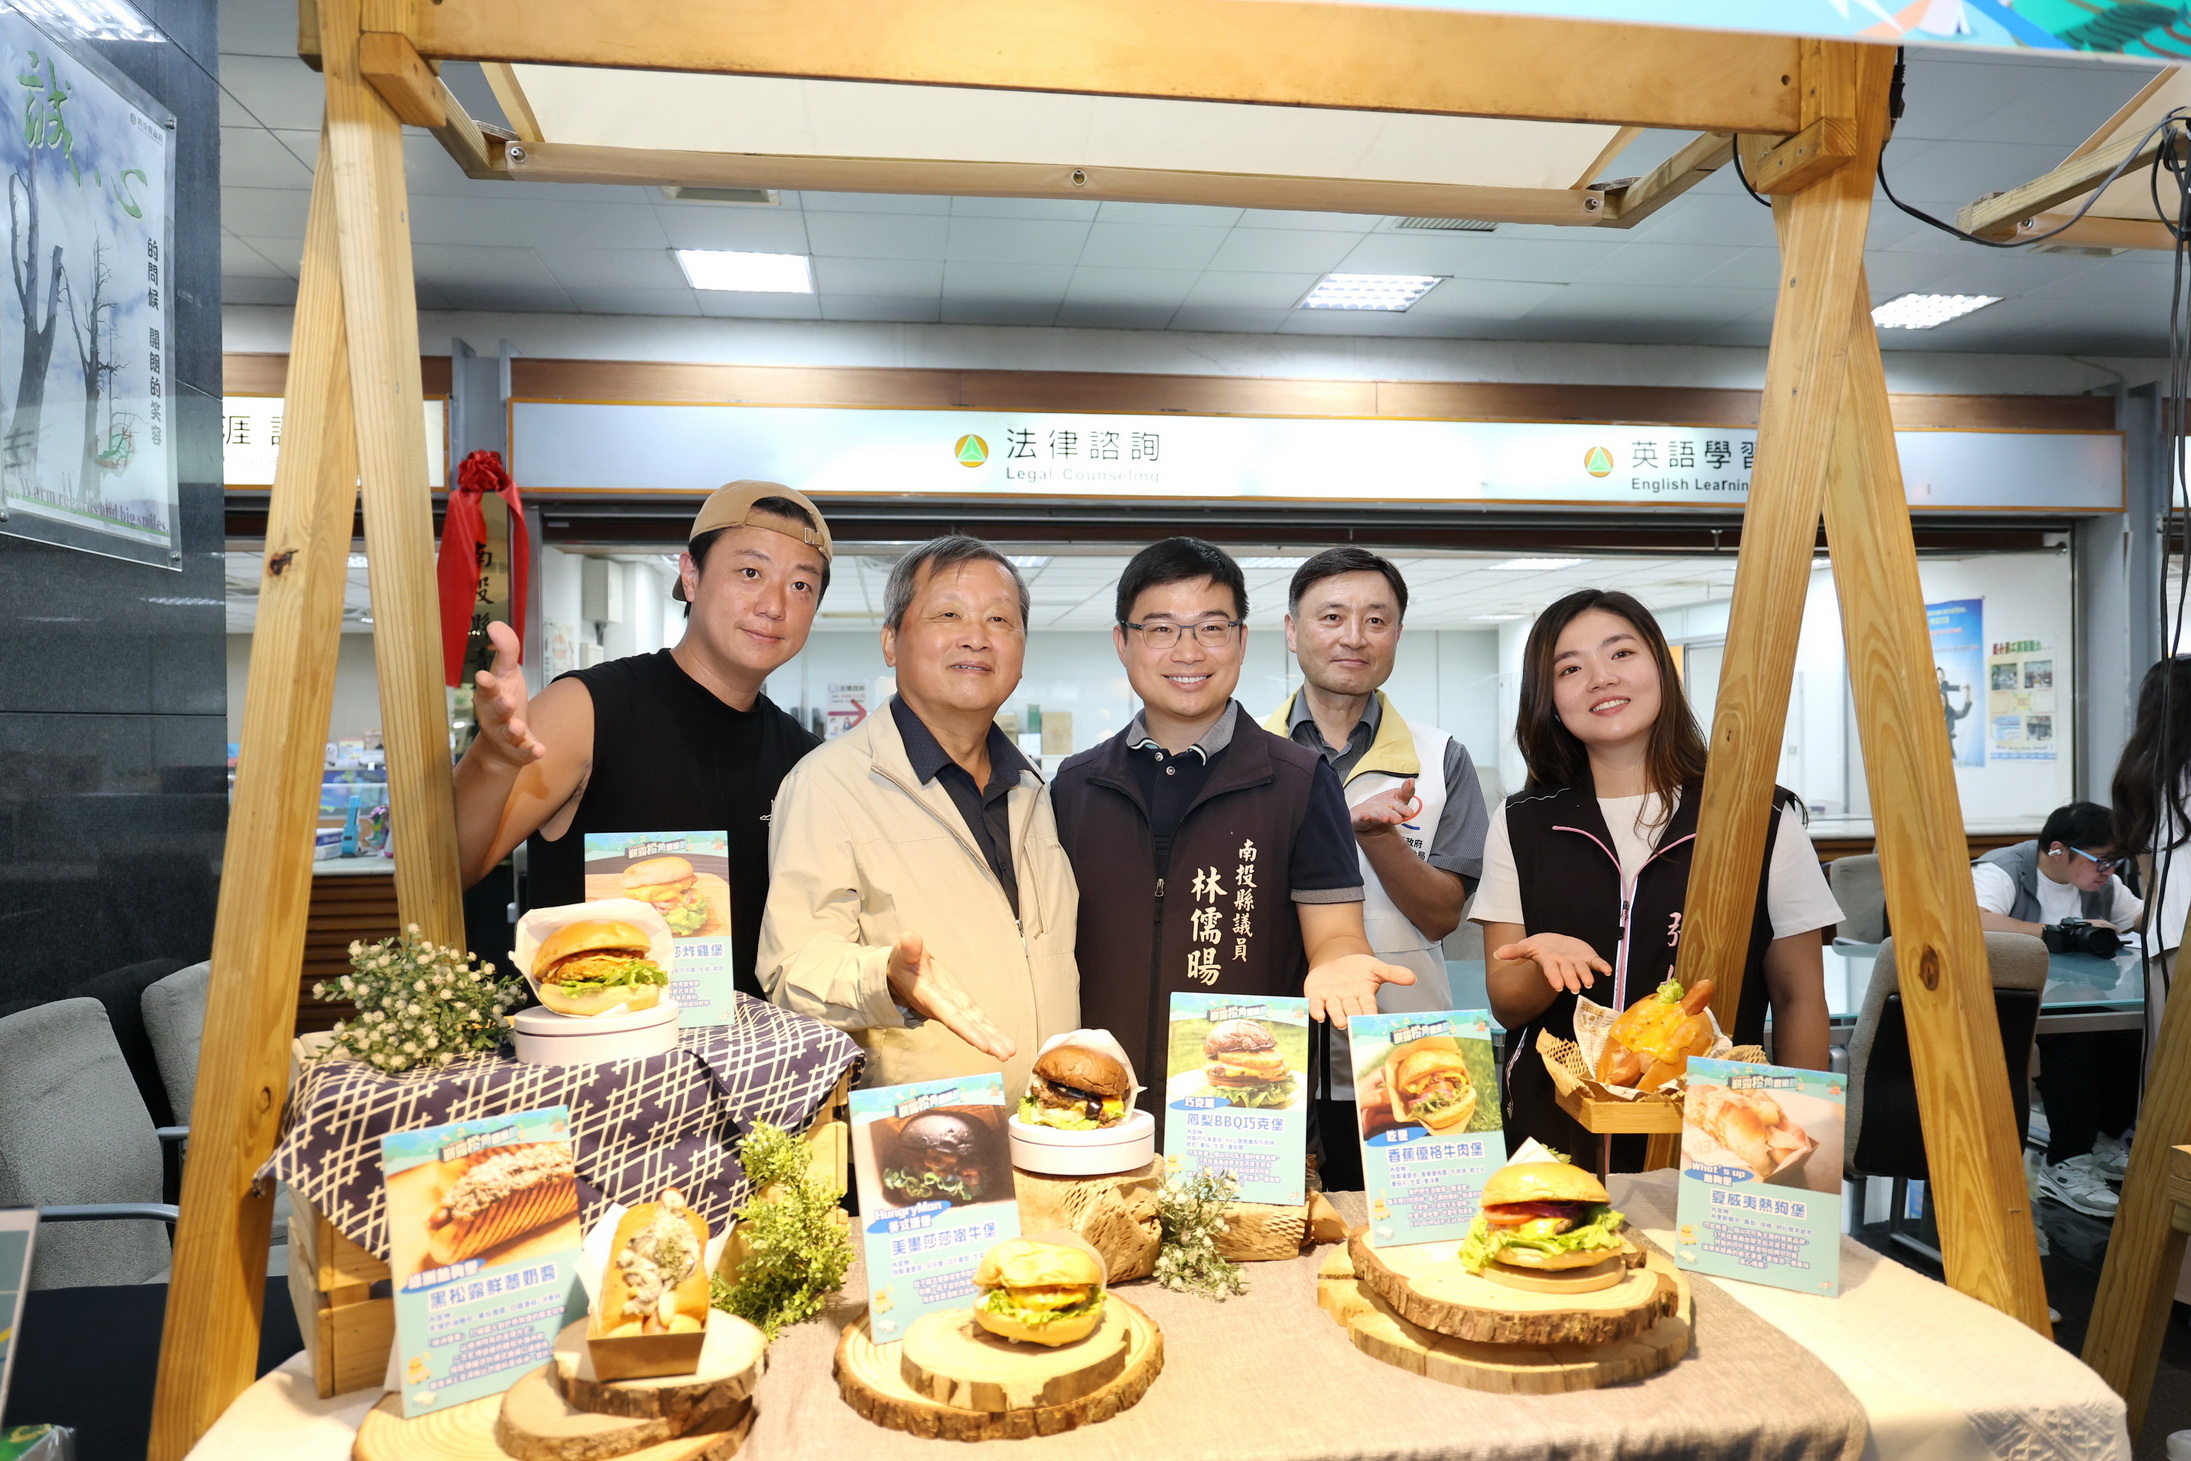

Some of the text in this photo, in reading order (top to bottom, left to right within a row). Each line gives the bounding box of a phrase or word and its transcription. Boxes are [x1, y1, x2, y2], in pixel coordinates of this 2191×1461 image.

[1007, 428, 1160, 461] 法律諮詢
[1006, 467, 1159, 483] Legal Counseling
[1632, 478, 1749, 493] English Learnin
[19, 477, 56, 503] Warm
[120, 506, 136, 528] big
[1402, 836, 1423, 849] 政府
[1232, 838, 1258, 963] 南投縣議員
[1187, 865, 1228, 987] 林儒暘
[1388, 1142, 1483, 1163] 香蕉優格牛肉堡
[1732, 1168, 1746, 1179] up
[874, 1201, 942, 1221] HungryMan
[1712, 1190, 1805, 1218] 夏威夷熱狗堡
[892, 1222, 997, 1256] 美墨莎莎嫩牛堡
